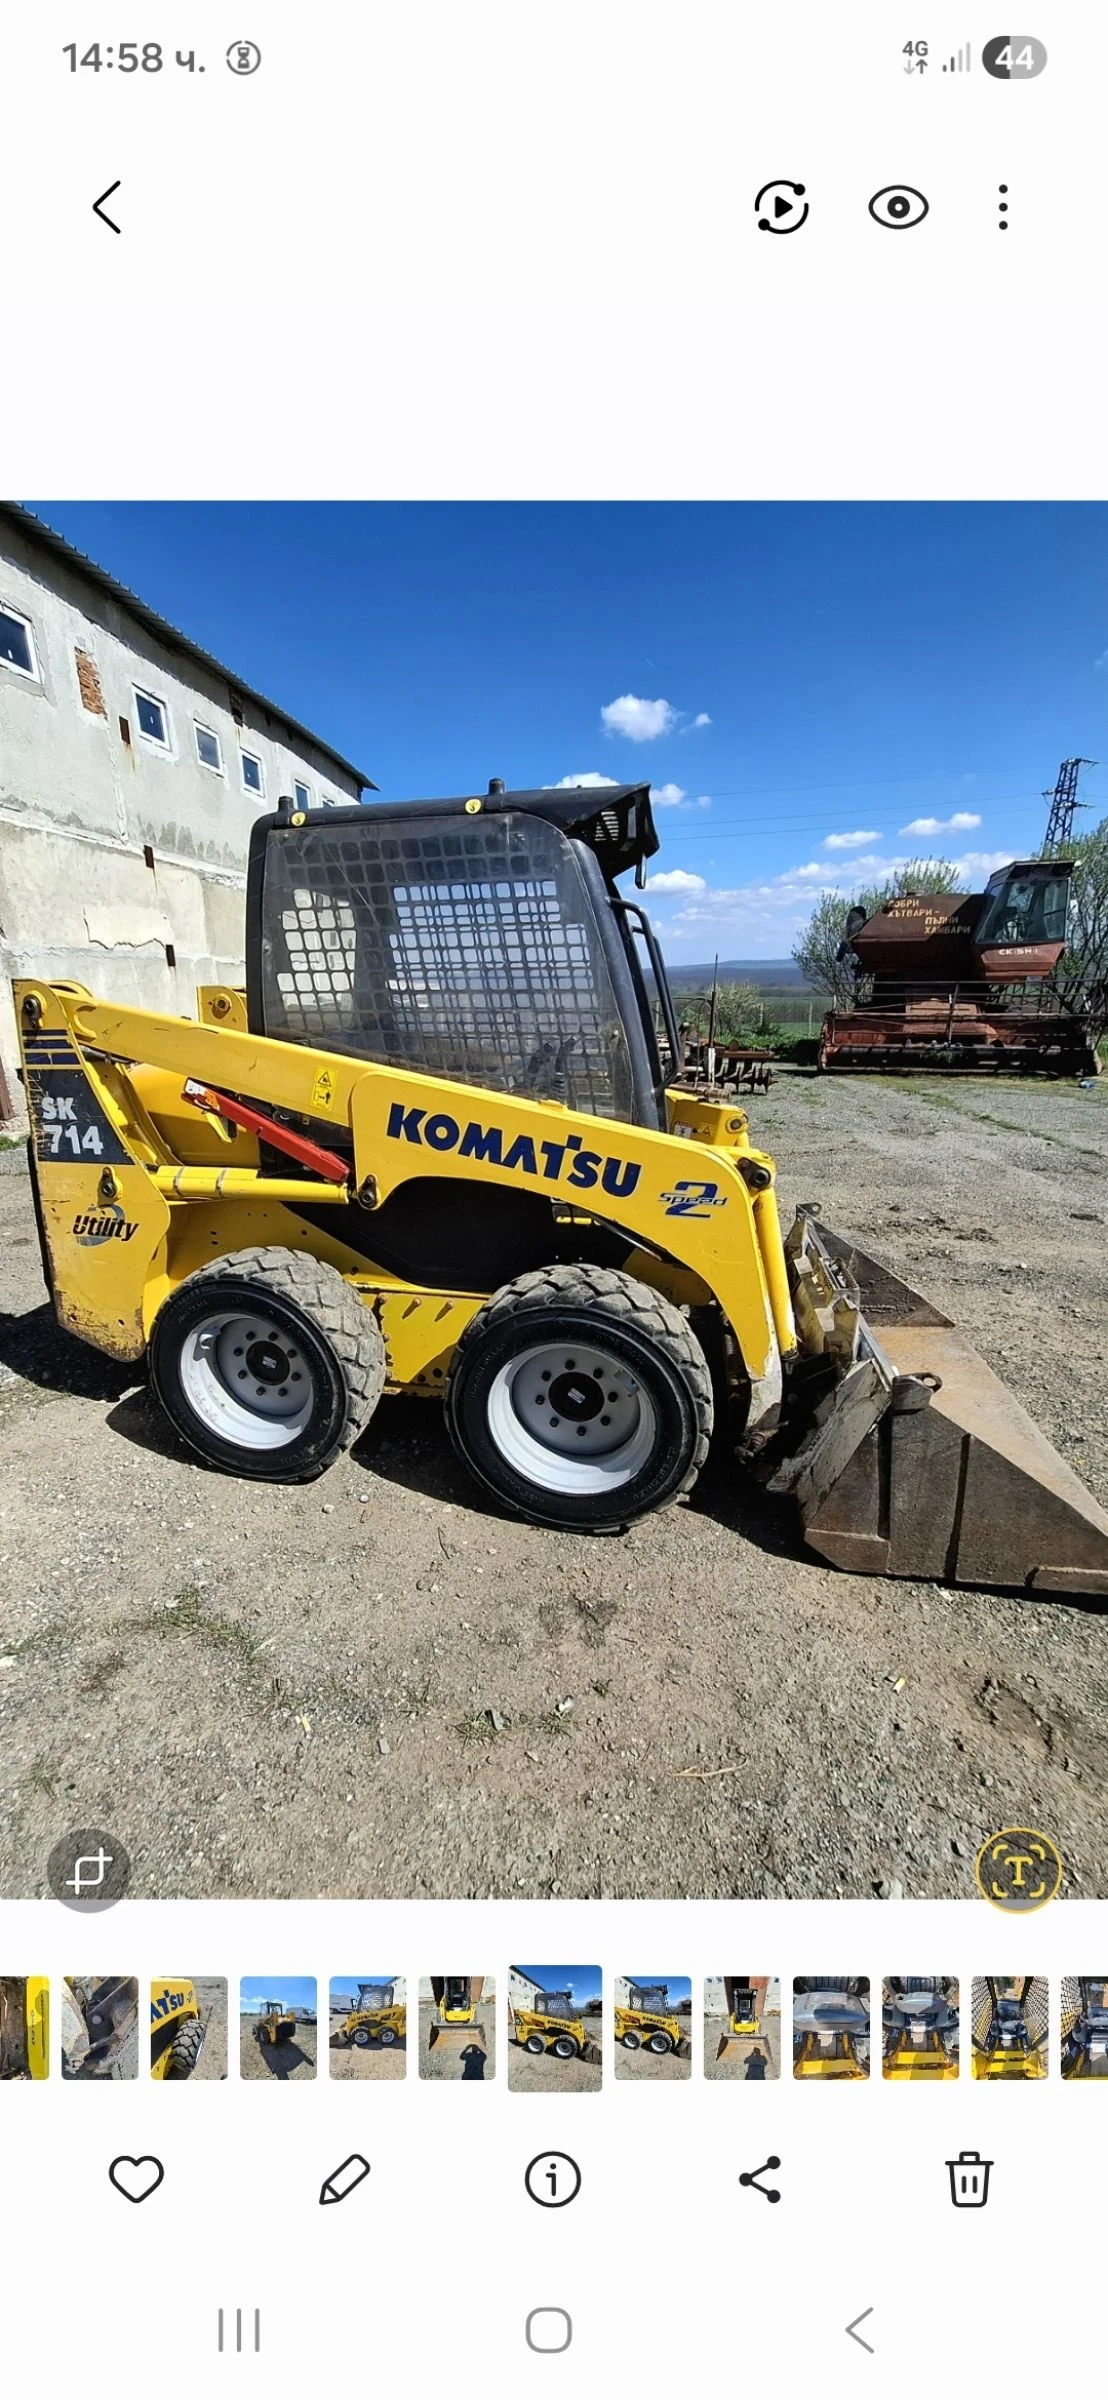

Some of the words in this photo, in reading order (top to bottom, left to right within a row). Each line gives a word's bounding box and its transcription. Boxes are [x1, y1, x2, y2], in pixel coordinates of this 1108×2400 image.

[62, 42, 163, 73] 14:58
[175, 50, 206, 73] ч.
[902, 40, 929, 57] 4G
[994, 44, 1035, 71] 44
[42, 1096, 77, 1120] SK
[43, 1124, 104, 1155] 714
[386, 1102, 642, 1198] KOMATSU
[665, 1181, 718, 1218] 2
[72, 1215, 139, 1241] Utility
